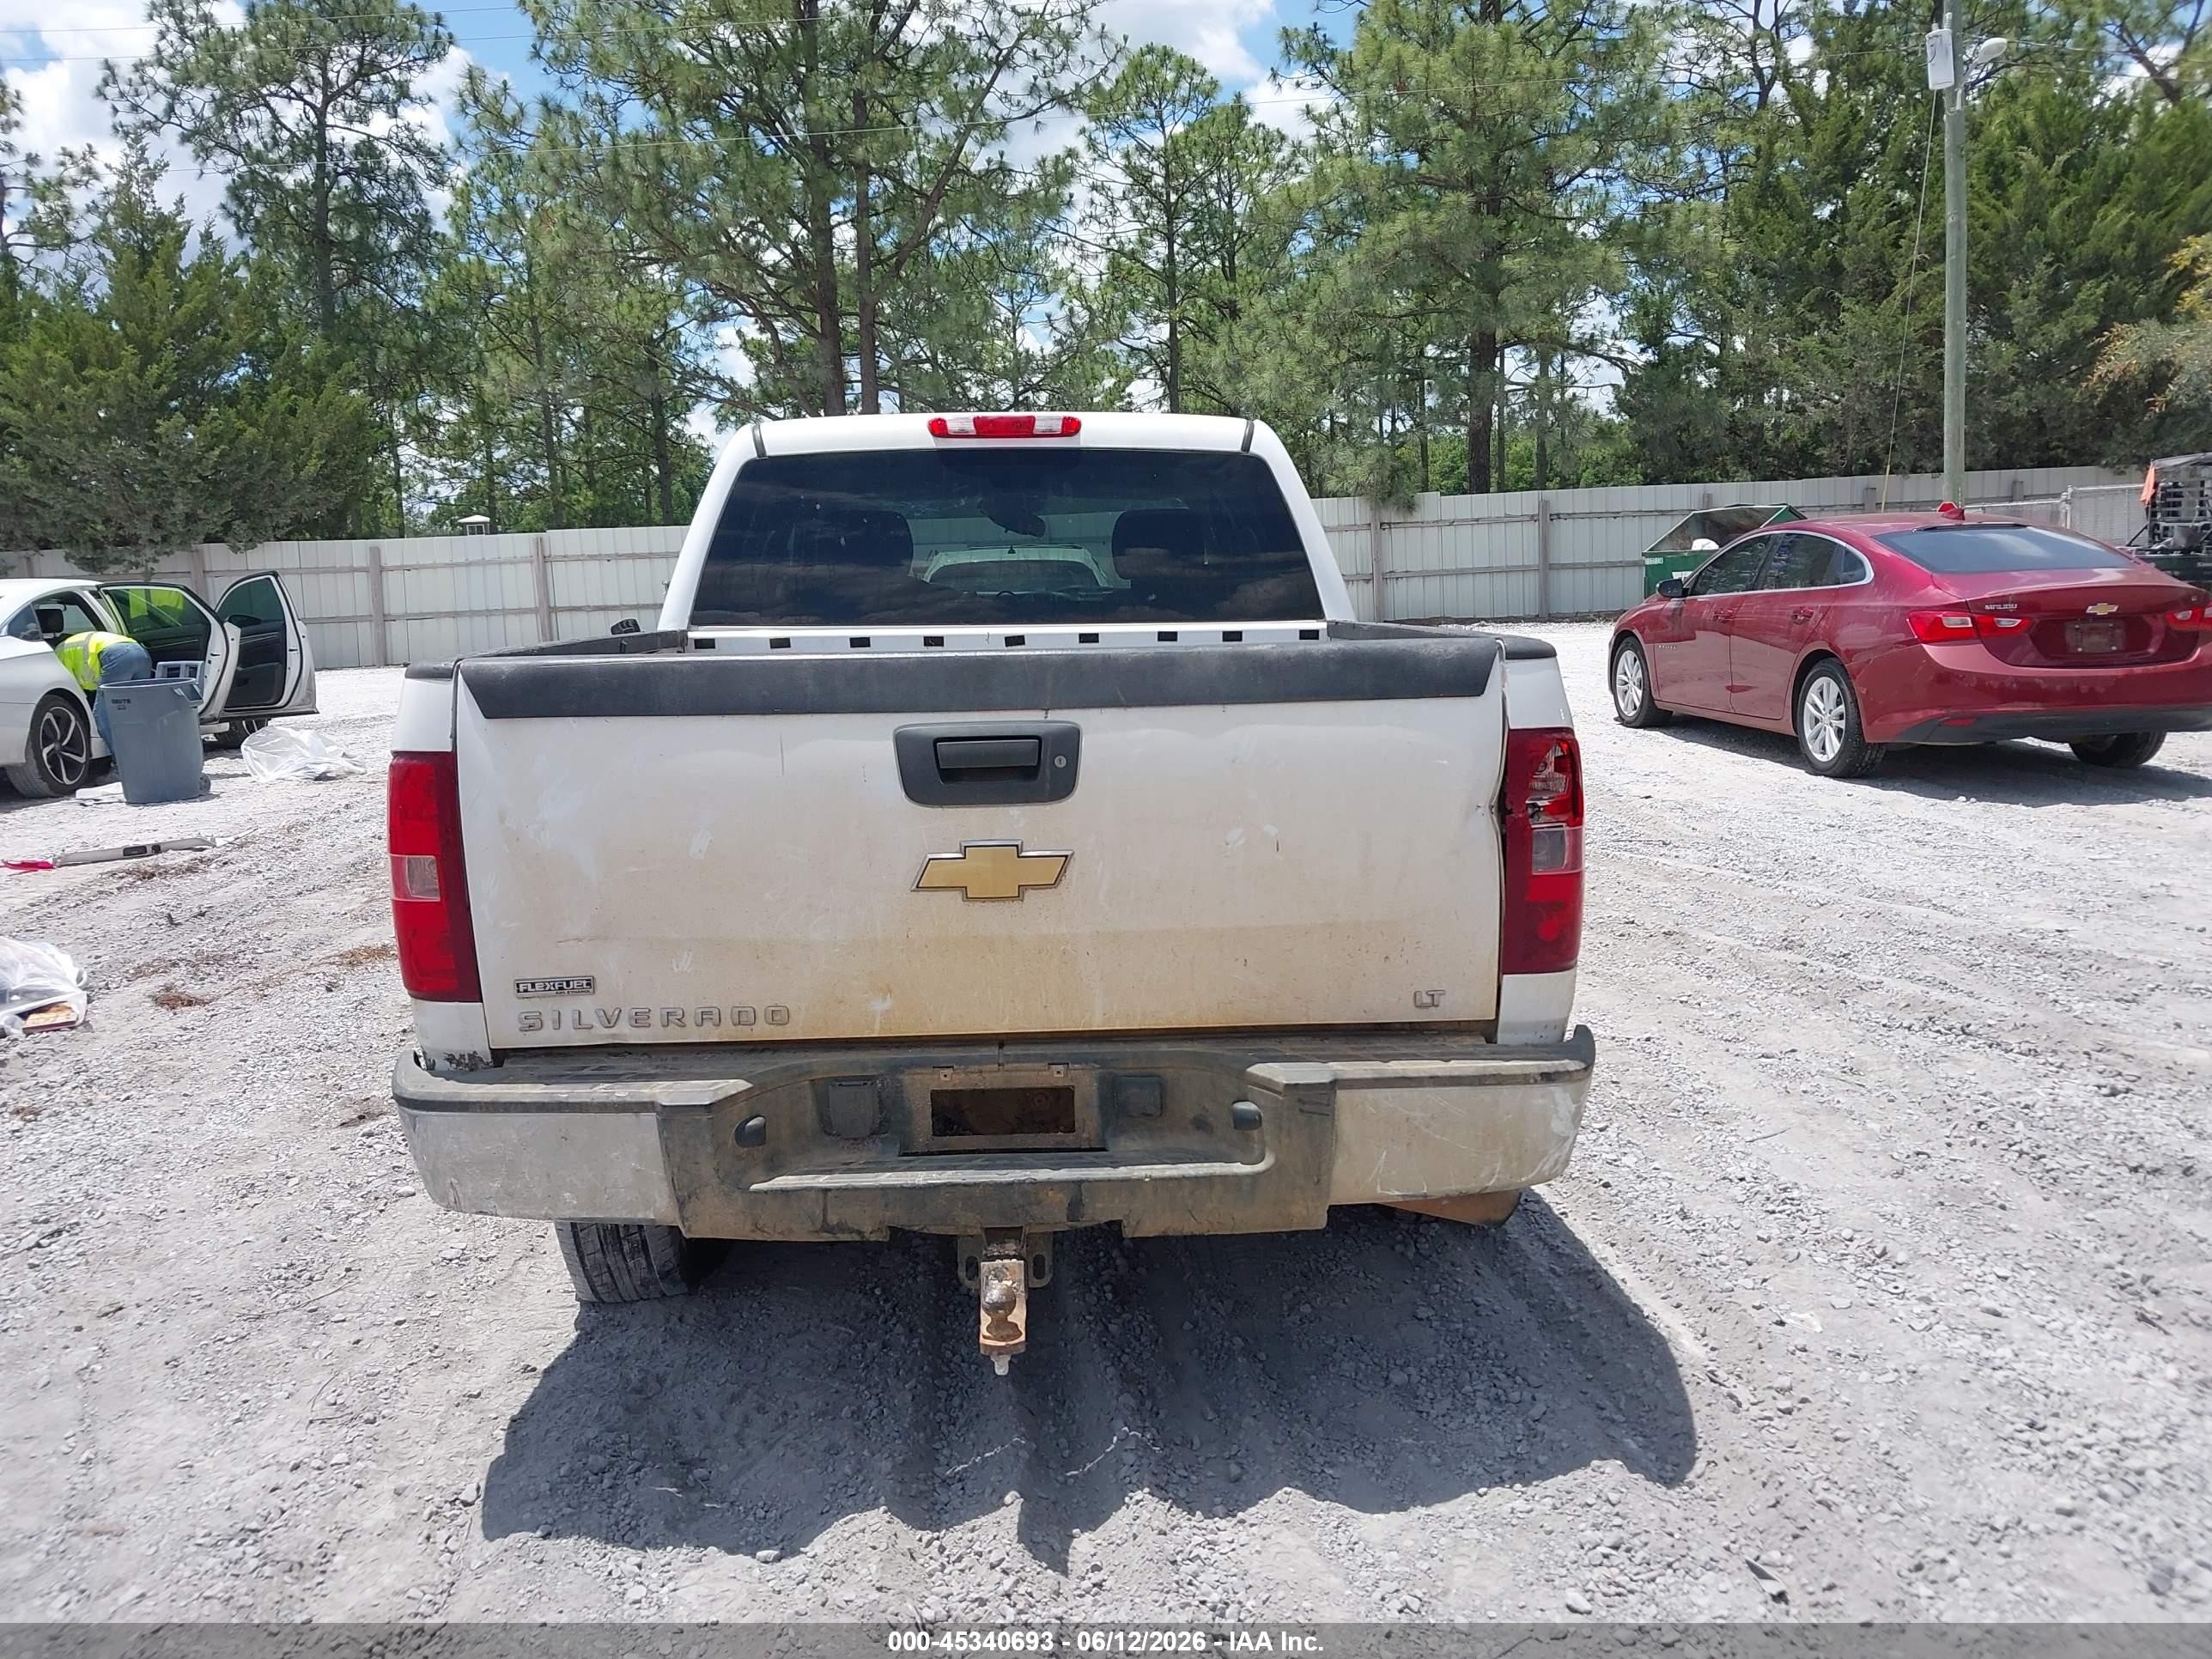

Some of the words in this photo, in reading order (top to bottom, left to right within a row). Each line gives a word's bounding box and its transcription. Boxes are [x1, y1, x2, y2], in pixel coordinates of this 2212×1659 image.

[519, 980, 592, 991] FLEXFUEL
[1413, 989, 1446, 1009] LT
[518, 1006, 791, 1032] SILVERADO
